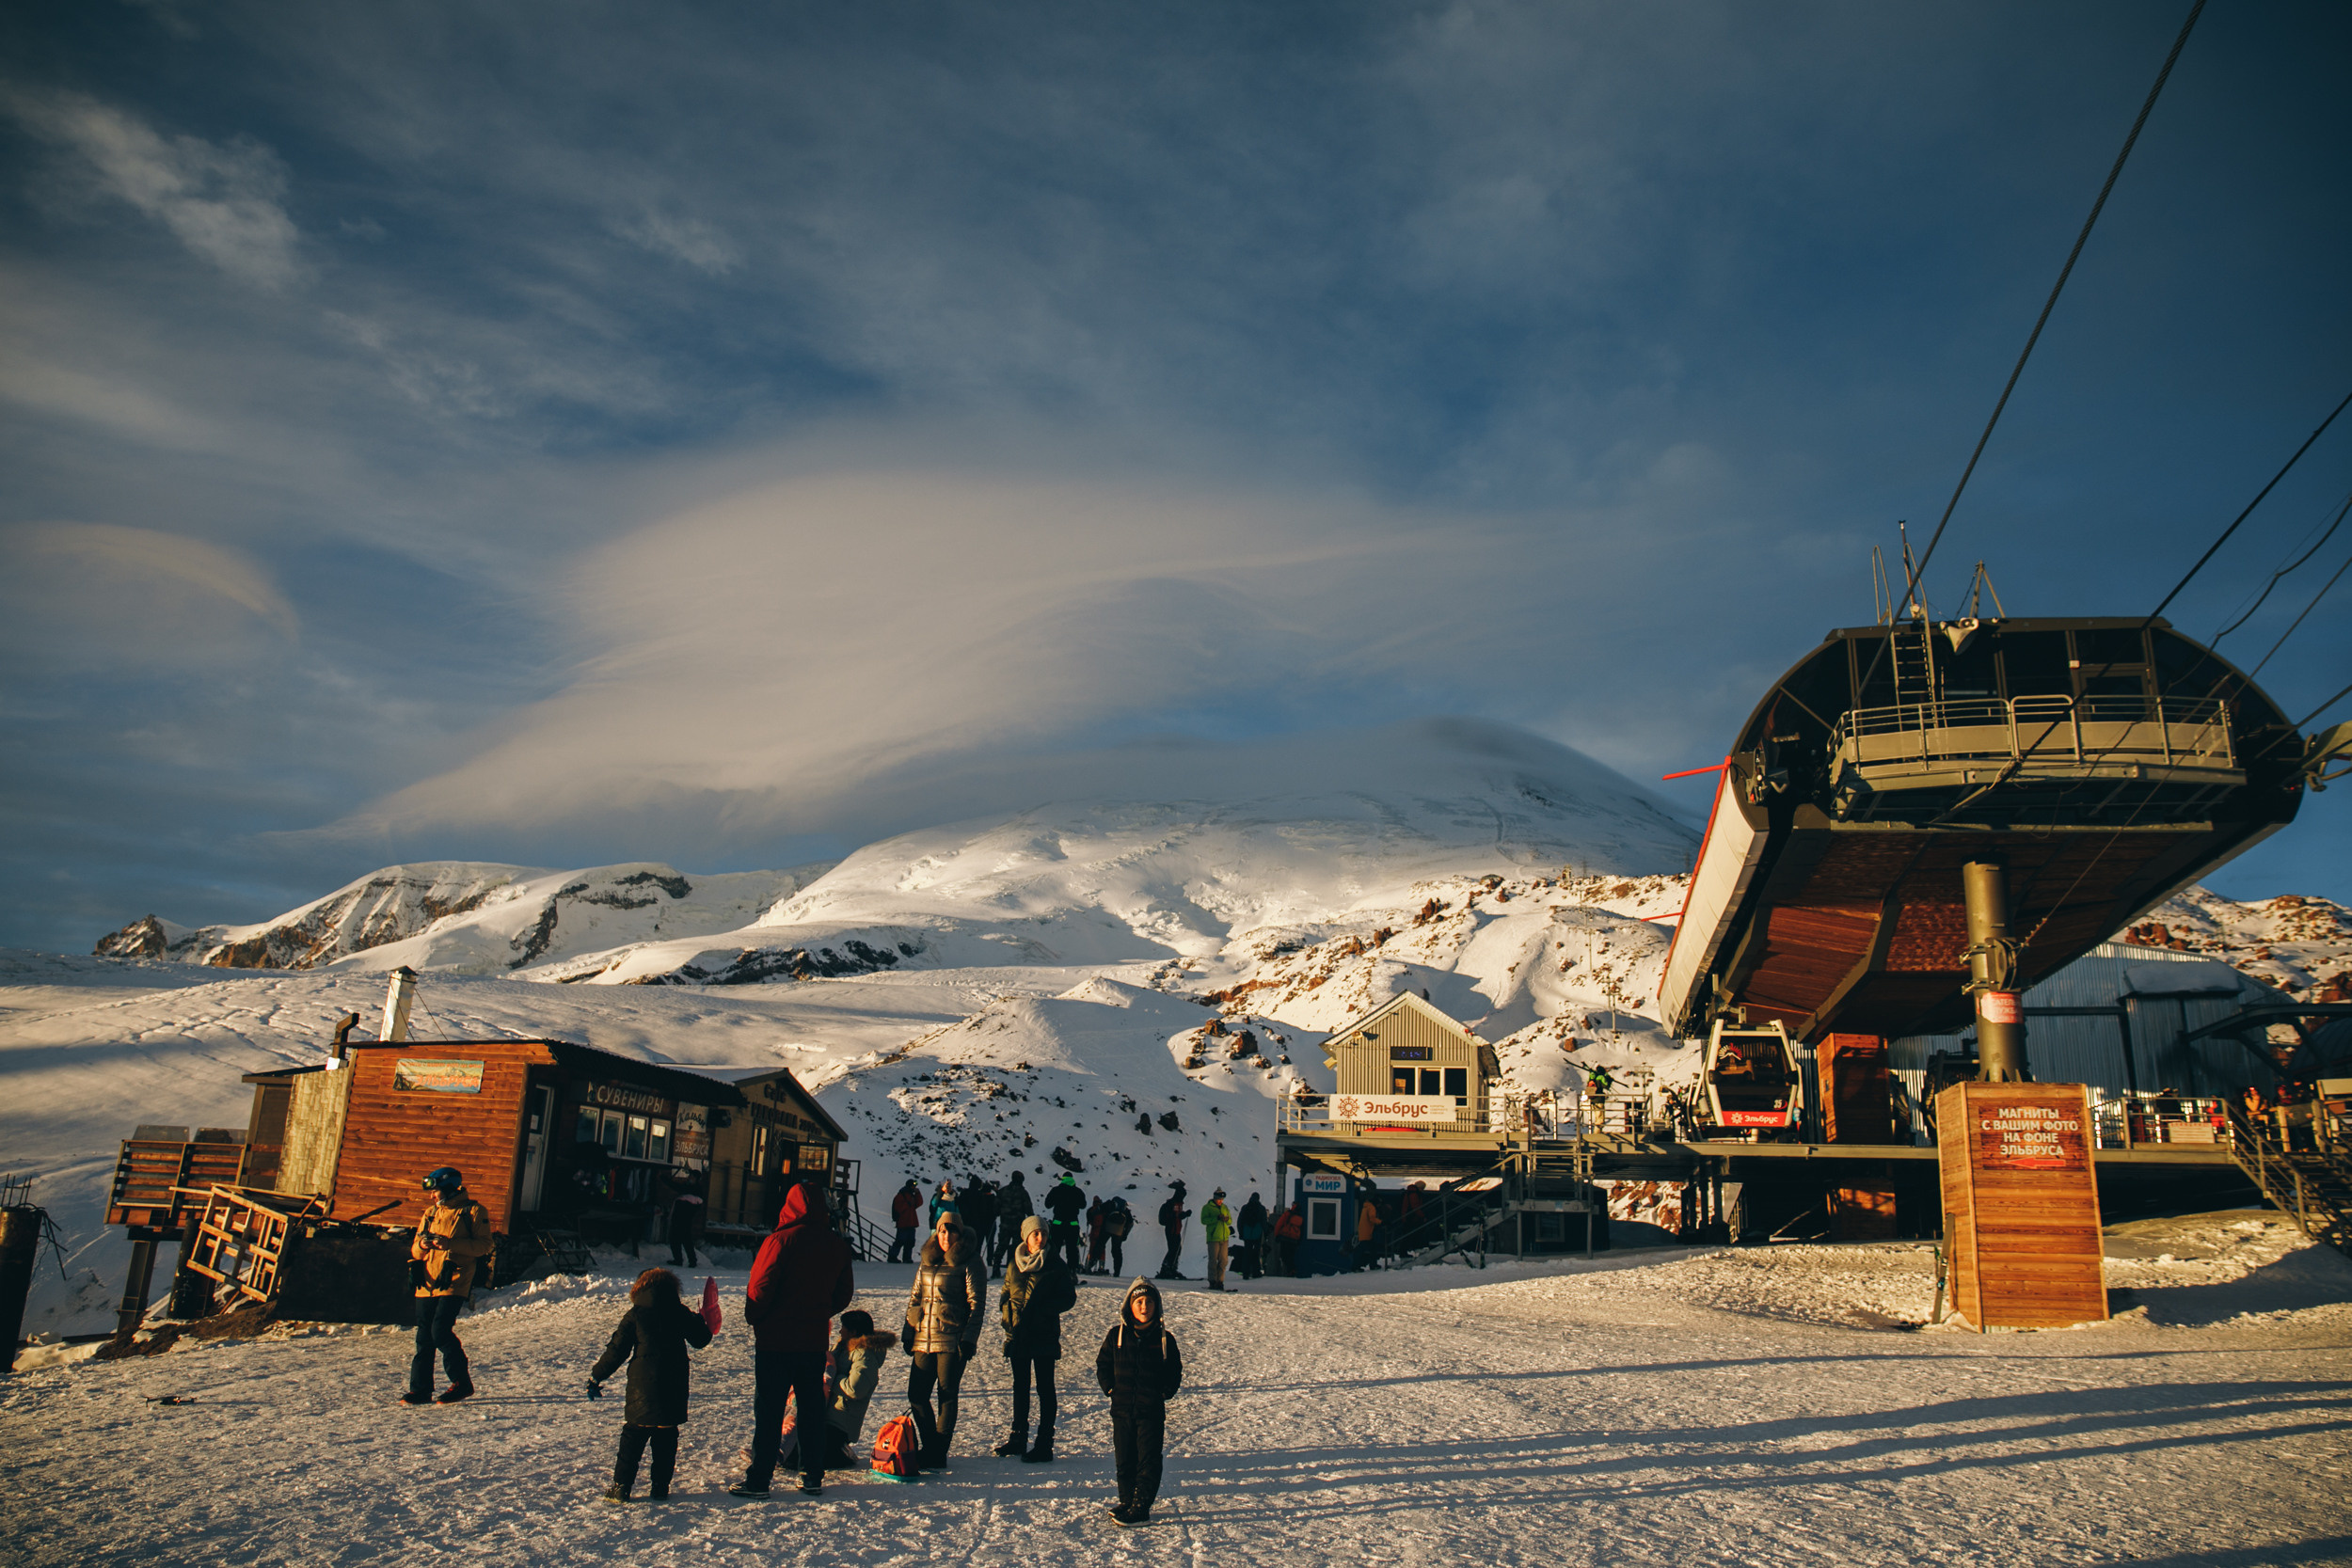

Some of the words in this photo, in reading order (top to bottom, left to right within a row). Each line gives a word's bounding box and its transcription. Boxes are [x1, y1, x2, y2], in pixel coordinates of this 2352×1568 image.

[415, 1075, 480, 1088] ЭЛЬБРУСА
[596, 1085, 664, 1114] СУВЕНИРЫ
[1364, 1101, 1428, 1117] Эльбрус
[1998, 1108, 2059, 1119] МАГНИТЫ
[1744, 1115, 1778, 1124] Эльбрус
[1981, 1119, 1992, 1131] С
[1993, 1119, 2041, 1131] ВАШИМ
[2042, 1120, 2078, 1132] ФОТО
[2003, 1132, 2022, 1143] НА
[2023, 1132, 2059, 1143] ФОНЕ
[675, 1140, 709, 1156] ЭЛЬБРУСА
[1999, 1145, 2065, 1156] ЭЛЬБРУСА
[1315, 1180, 1341, 1191] МИР
